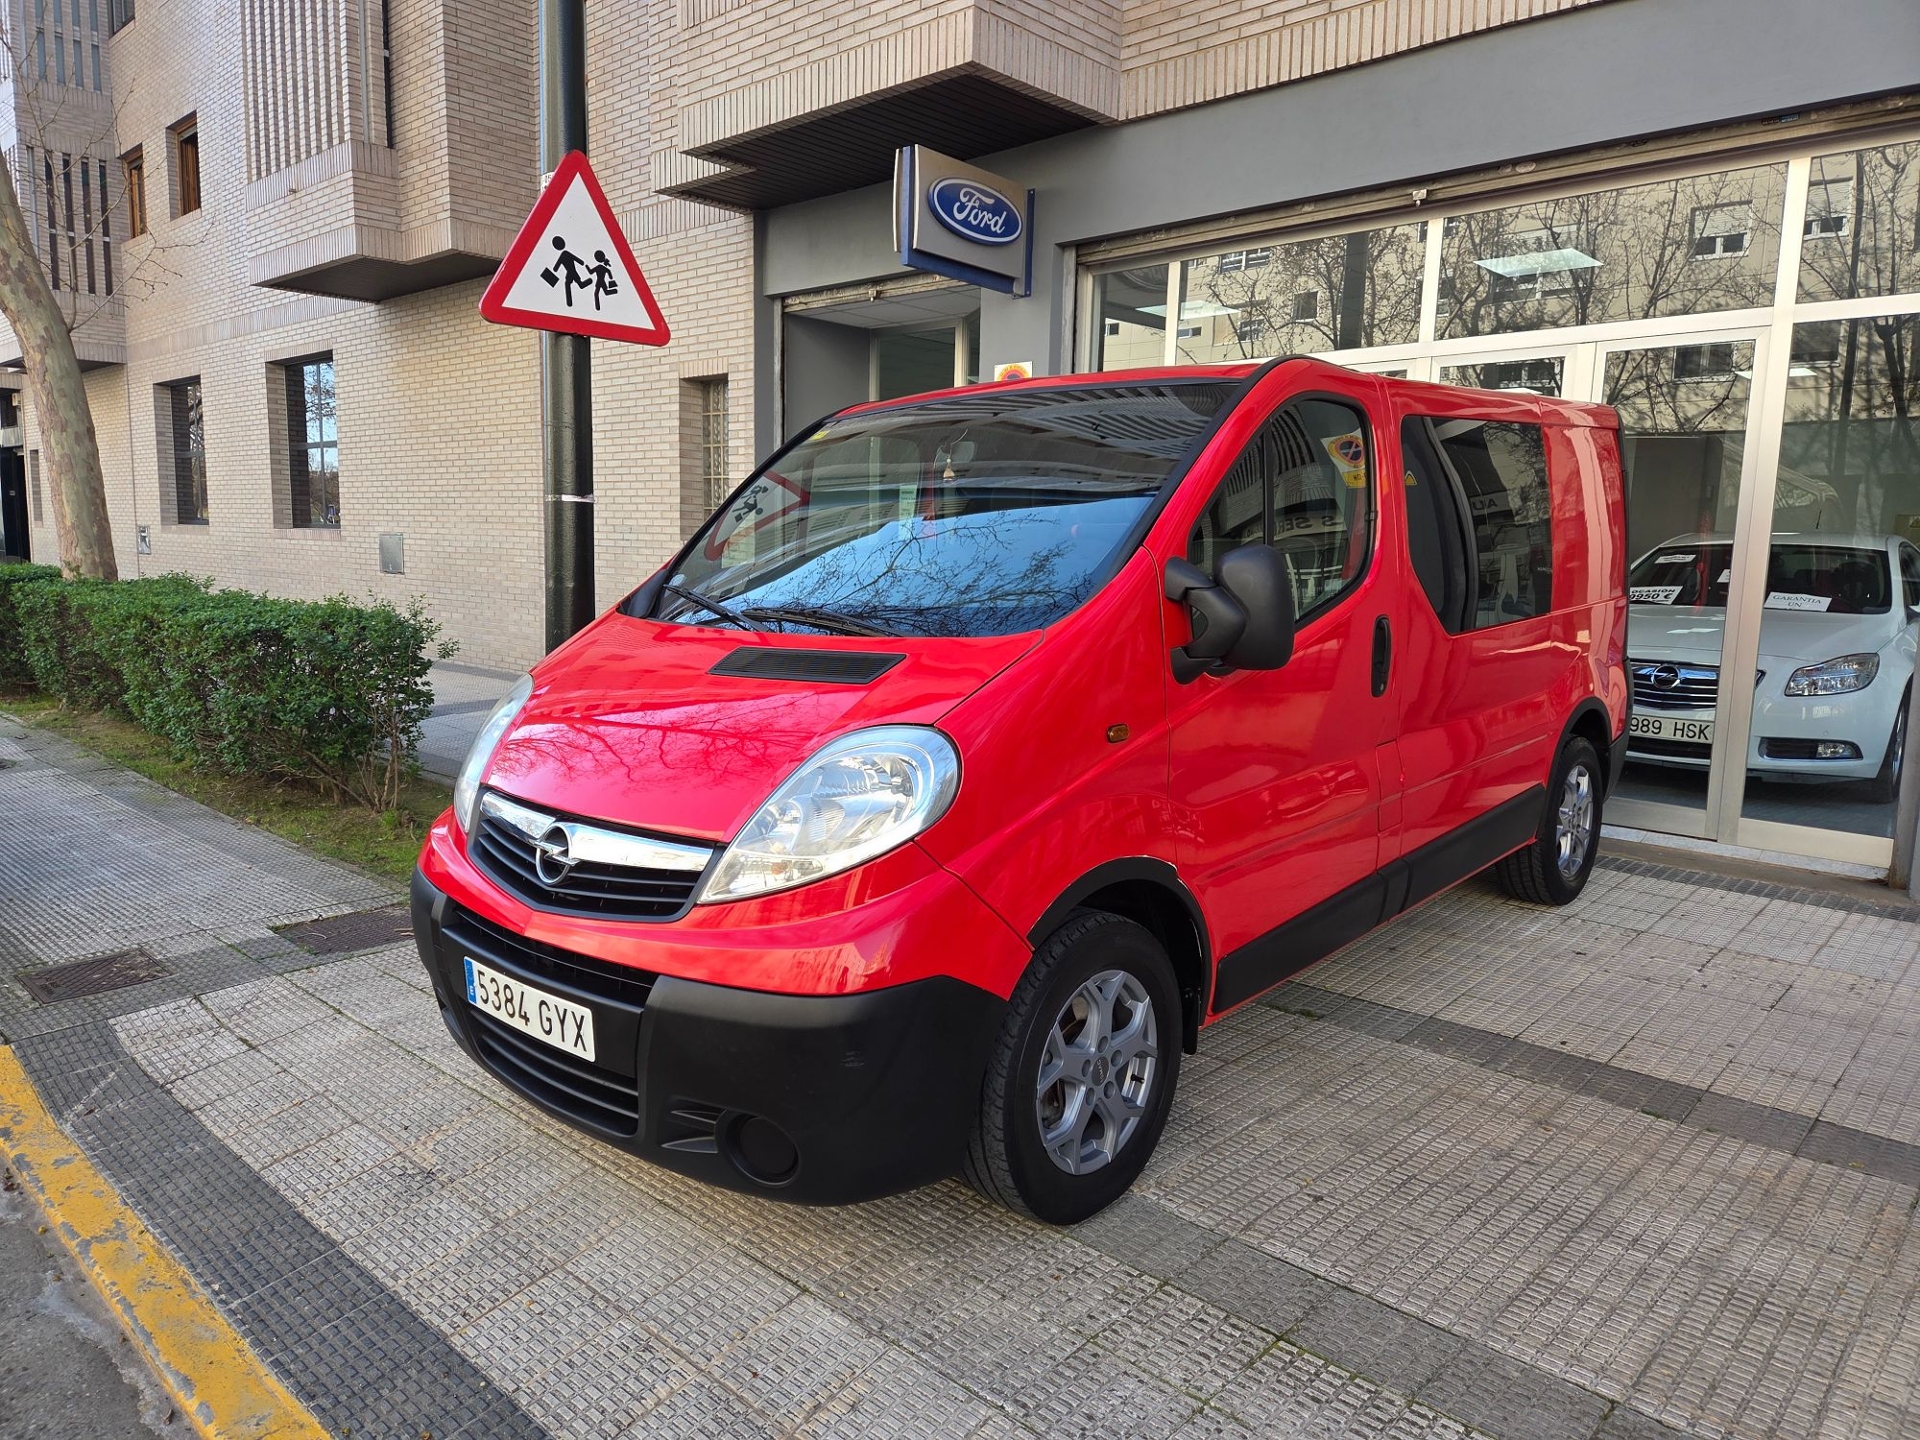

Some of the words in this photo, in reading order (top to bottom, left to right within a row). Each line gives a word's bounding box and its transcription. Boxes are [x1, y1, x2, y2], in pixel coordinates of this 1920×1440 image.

[953, 187, 1007, 235] Ford
[1673, 721, 1711, 741] HSK
[477, 969, 530, 1027] 5384
[538, 999, 587, 1053] GYX
